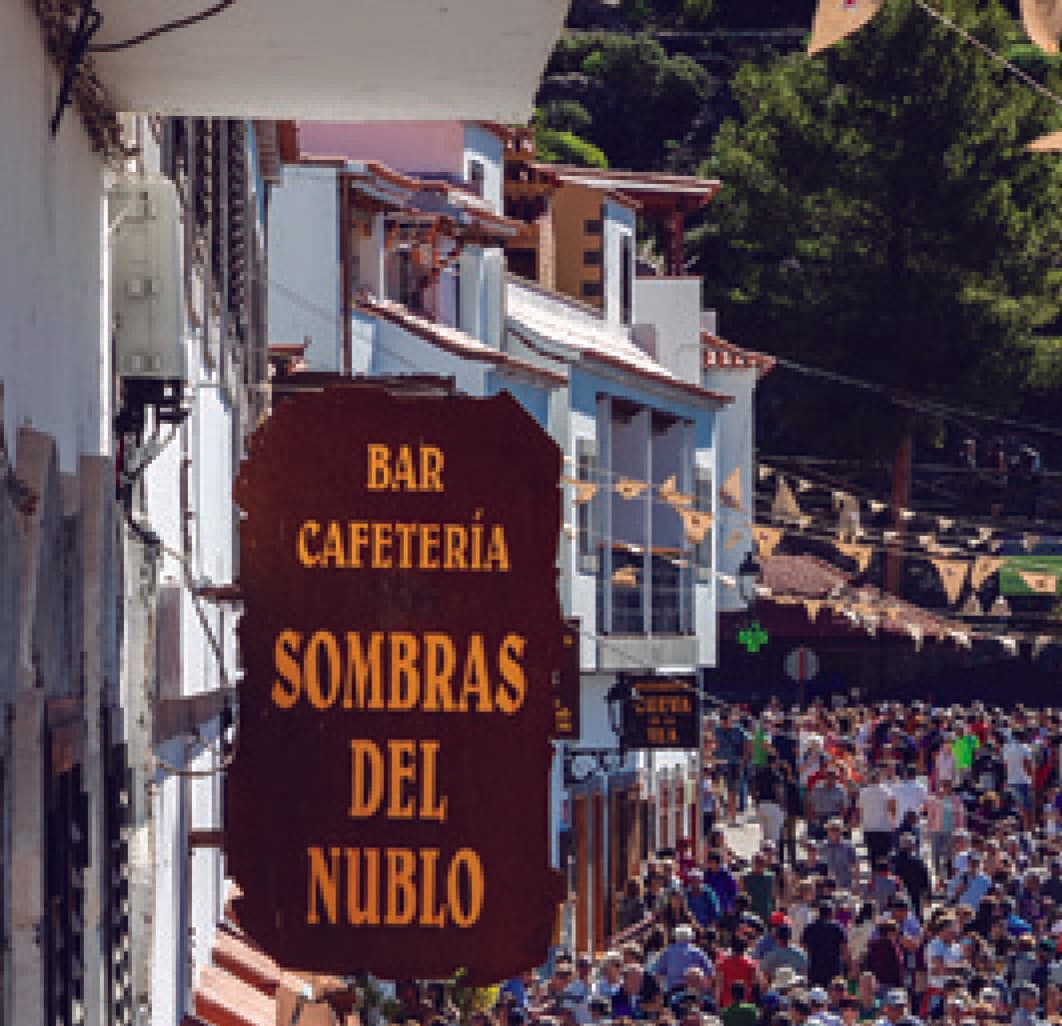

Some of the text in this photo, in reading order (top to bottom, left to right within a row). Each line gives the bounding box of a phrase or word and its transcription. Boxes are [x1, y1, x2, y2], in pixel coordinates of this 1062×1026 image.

[366, 443, 445, 492] BAR
[296, 508, 510, 572] CAFETERÍA
[271, 629, 528, 714] SOMBRAS
[350, 738, 448, 822] DEL
[306, 846, 485, 929] NUBLO
